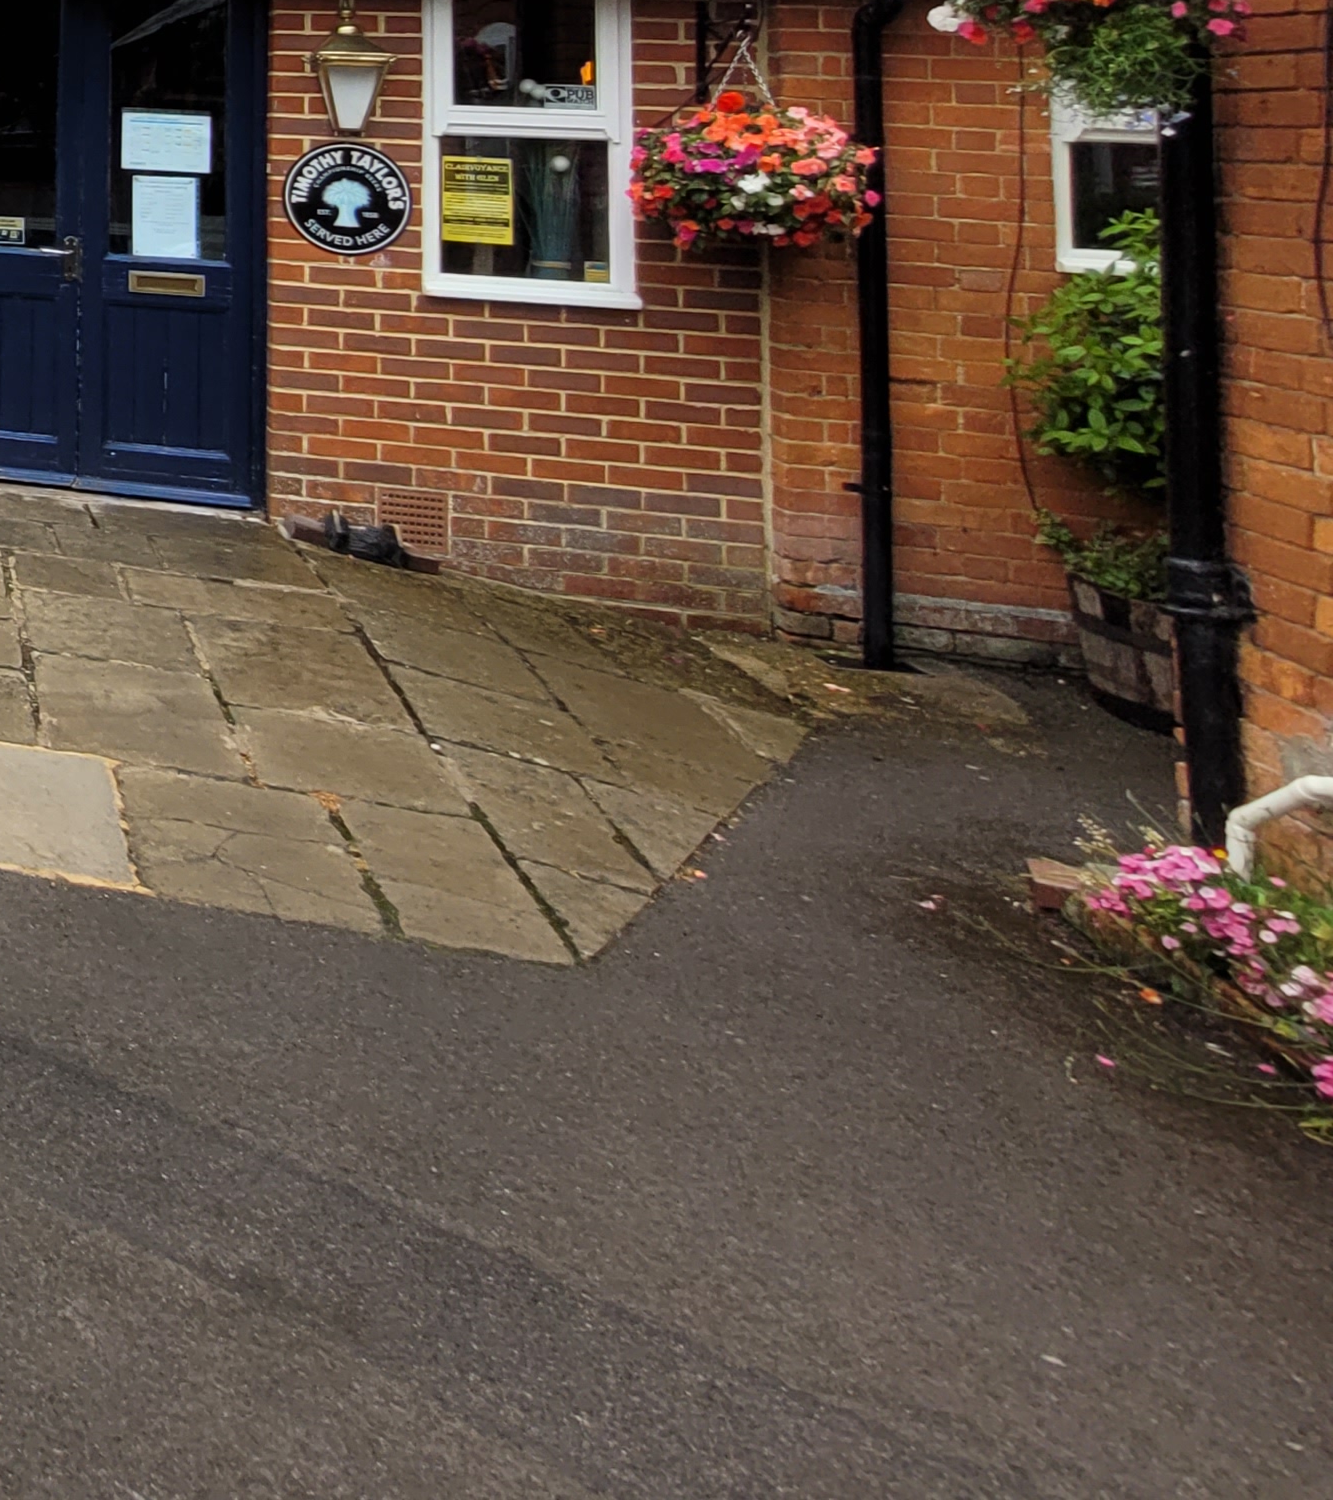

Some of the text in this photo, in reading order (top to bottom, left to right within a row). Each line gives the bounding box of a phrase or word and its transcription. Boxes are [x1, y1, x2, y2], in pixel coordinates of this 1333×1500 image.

[566, 89, 595, 100] PUB
[291, 150, 408, 211] TIMOTHY TAYLOR'S
[304, 218, 391, 247] SERVED HERE
